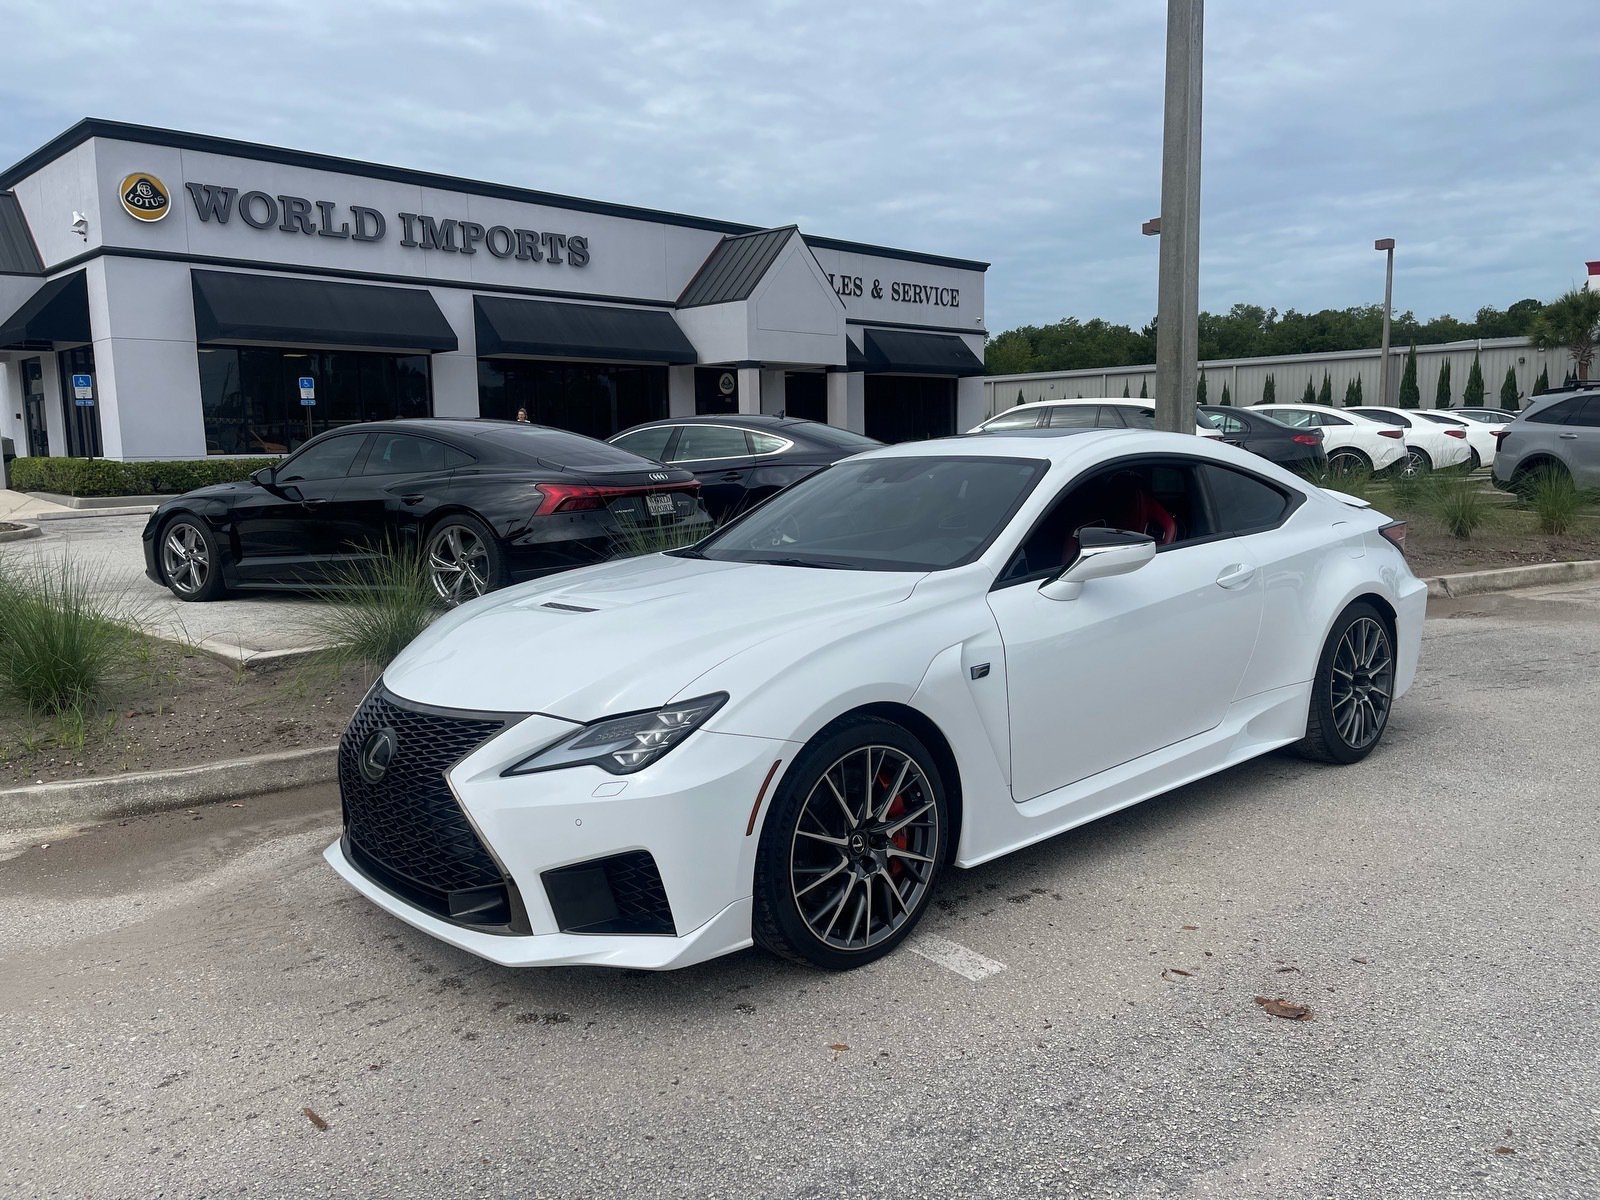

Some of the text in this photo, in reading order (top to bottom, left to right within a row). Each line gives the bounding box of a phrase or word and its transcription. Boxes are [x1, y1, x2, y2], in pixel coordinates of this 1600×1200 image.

[127, 193, 165, 207] LOTUS
[185, 182, 591, 267] WORLD IMPORTS
[871, 279, 884, 300] &
[891, 281, 960, 308] SERVICE
